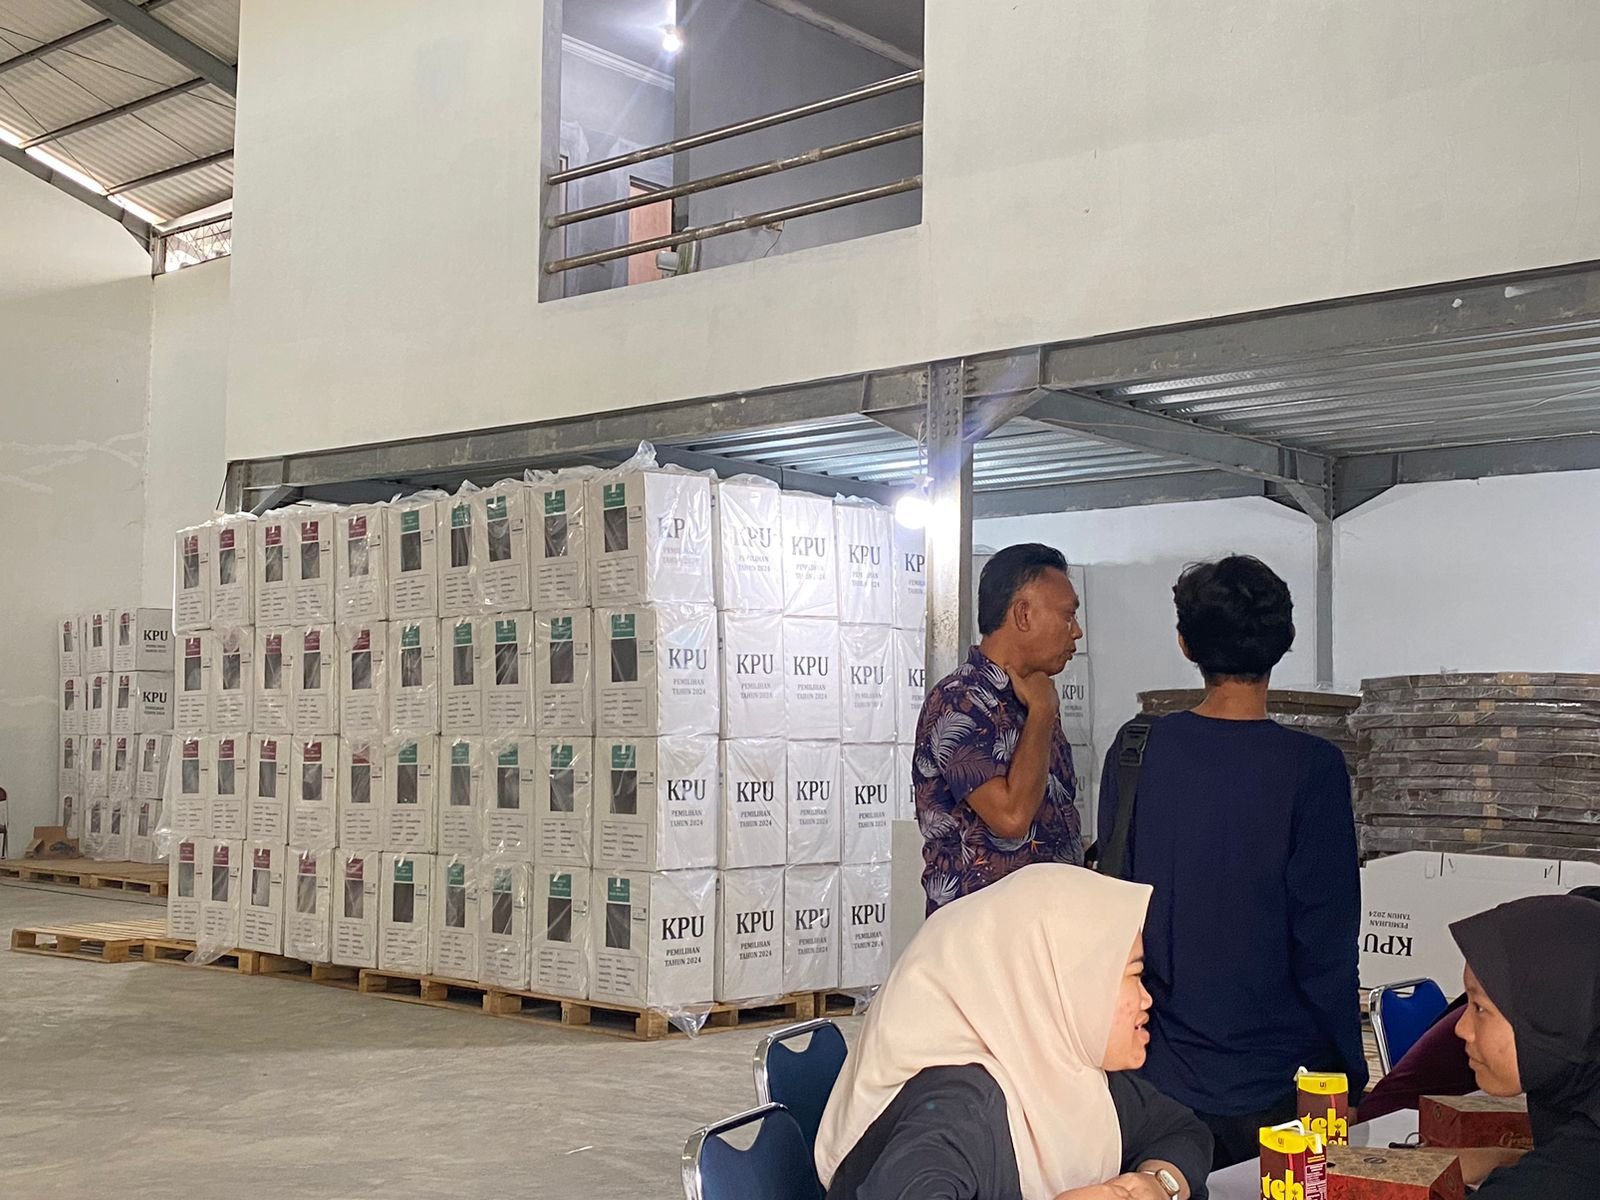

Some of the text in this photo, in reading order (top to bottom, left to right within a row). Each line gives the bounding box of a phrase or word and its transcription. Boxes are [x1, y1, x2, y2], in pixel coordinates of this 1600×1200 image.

[791, 536, 826, 558] KPU
[848, 544, 881, 566] KPU
[905, 553, 925, 573] KP
[143, 630, 168, 641] KPU
[668, 648, 707, 670] KPU
[736, 654, 774, 675] KPU
[793, 656, 829, 677] KPU
[673, 678, 704, 686] PEMILIHAN
[850, 665, 884, 686] KPU
[692, 688, 706, 696] 2024
[741, 682, 771, 690] PEMILIHAN
[1062, 684, 1084, 700] KPU
[143, 691, 168, 704] KPU
[666, 779, 706, 801] KPU
[736, 781, 774, 803] KPU
[796, 780, 831, 801] KPU
[854, 784, 887, 805] KPU
[740, 810, 771, 818] PEMILIHAN
[740, 820, 758, 828] TAHUN
[736, 910, 775, 935] KPU
[795, 908, 830, 930] KPU
[851, 903, 886, 926] KPU
[1368, 910, 1412, 920] TAHUN 2024
[661, 915, 705, 940] KPU
[1369, 919, 1409, 929] PEMILIHAN
[798, 937, 827, 946] PEMILIHAN
[855, 931, 882, 940] PEMILIHAN
[666, 946, 701, 957] PEMILIHAN
[740, 940, 771, 950] PEMILIHAN
[797, 947, 815, 955] TAHUN
[853, 942, 870, 950] TAHUN
[1363, 933, 1413, 957] KPU
[664, 956, 702, 967] TAHUN 2024
[739, 950, 772, 960] TAHUN 2024
[1300, 1108, 1347, 1138] teh
[1261, 1169, 1305, 1200] teh
